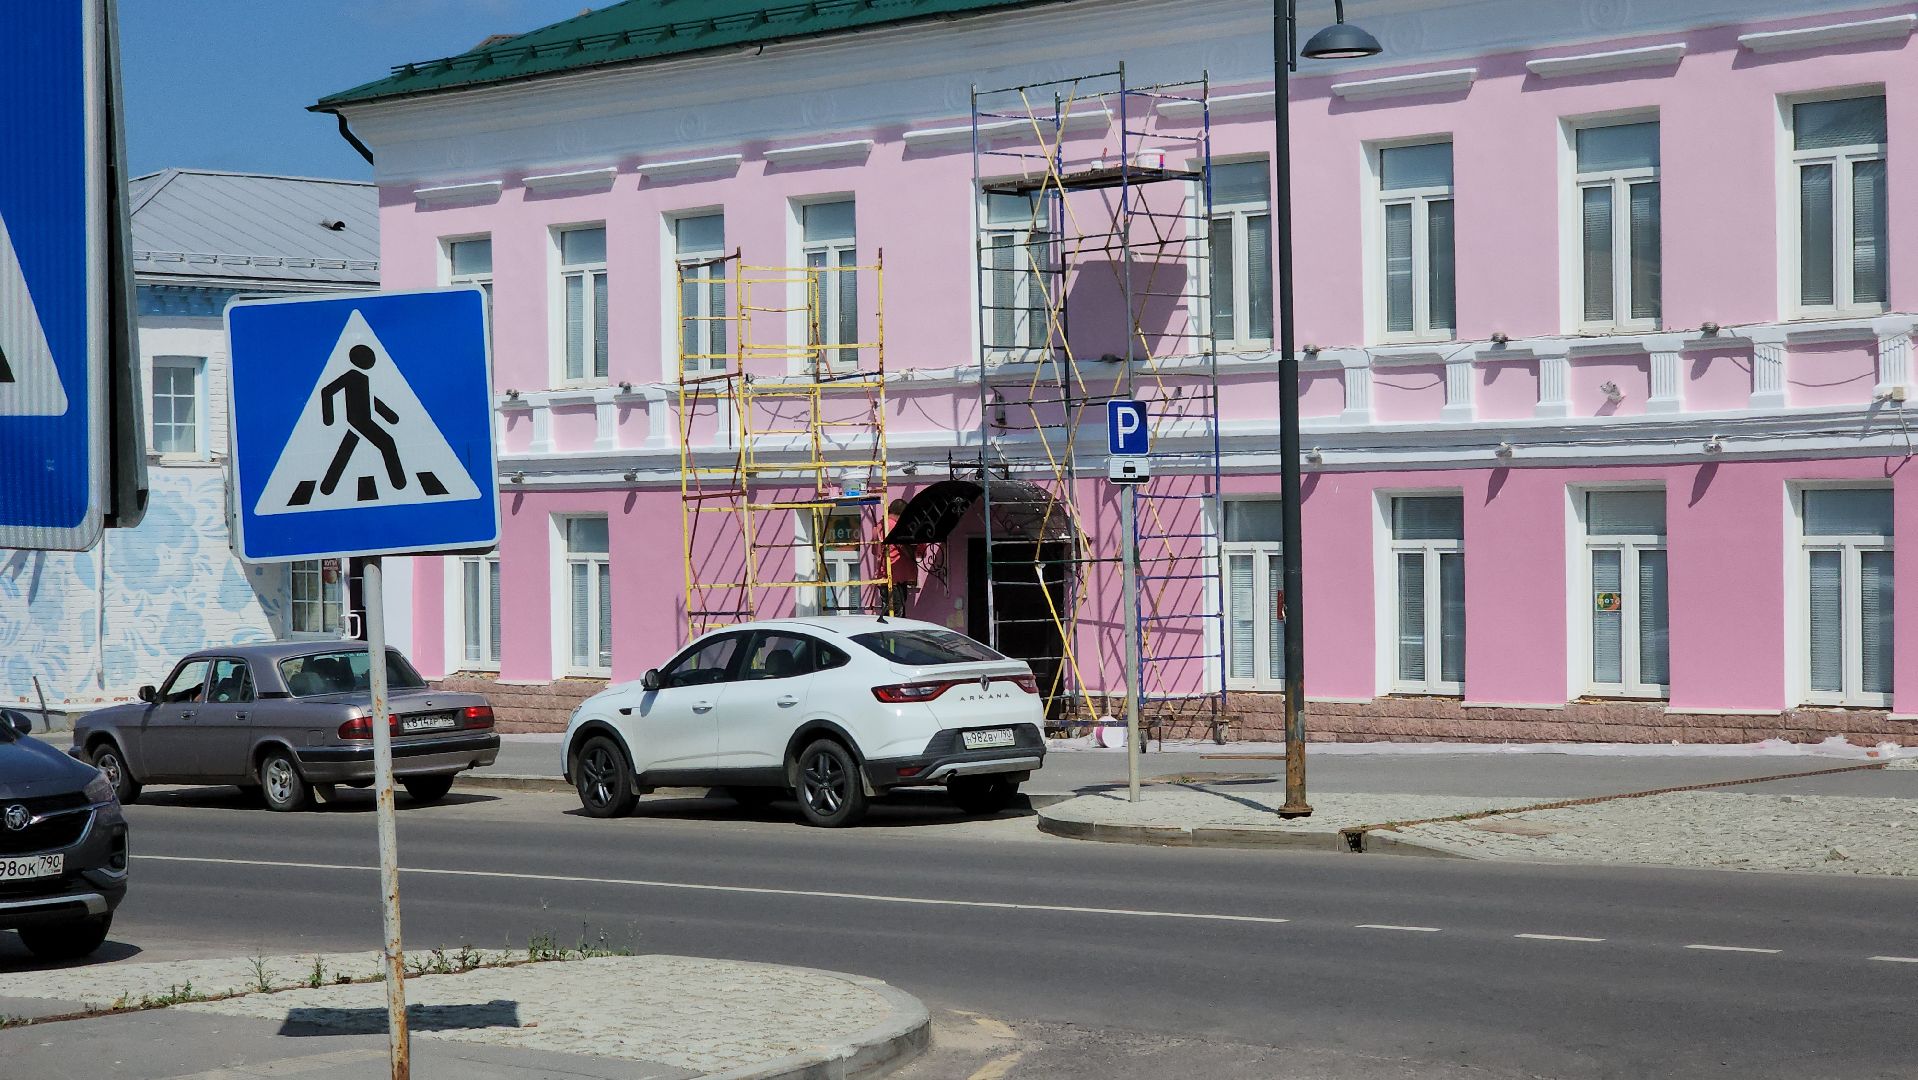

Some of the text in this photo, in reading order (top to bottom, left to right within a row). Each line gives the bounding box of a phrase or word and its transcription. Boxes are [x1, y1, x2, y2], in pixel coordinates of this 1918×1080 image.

[1117, 406, 1140, 449] P
[960, 693, 1010, 701] ARKANA
[40, 855, 60, 870] 790
